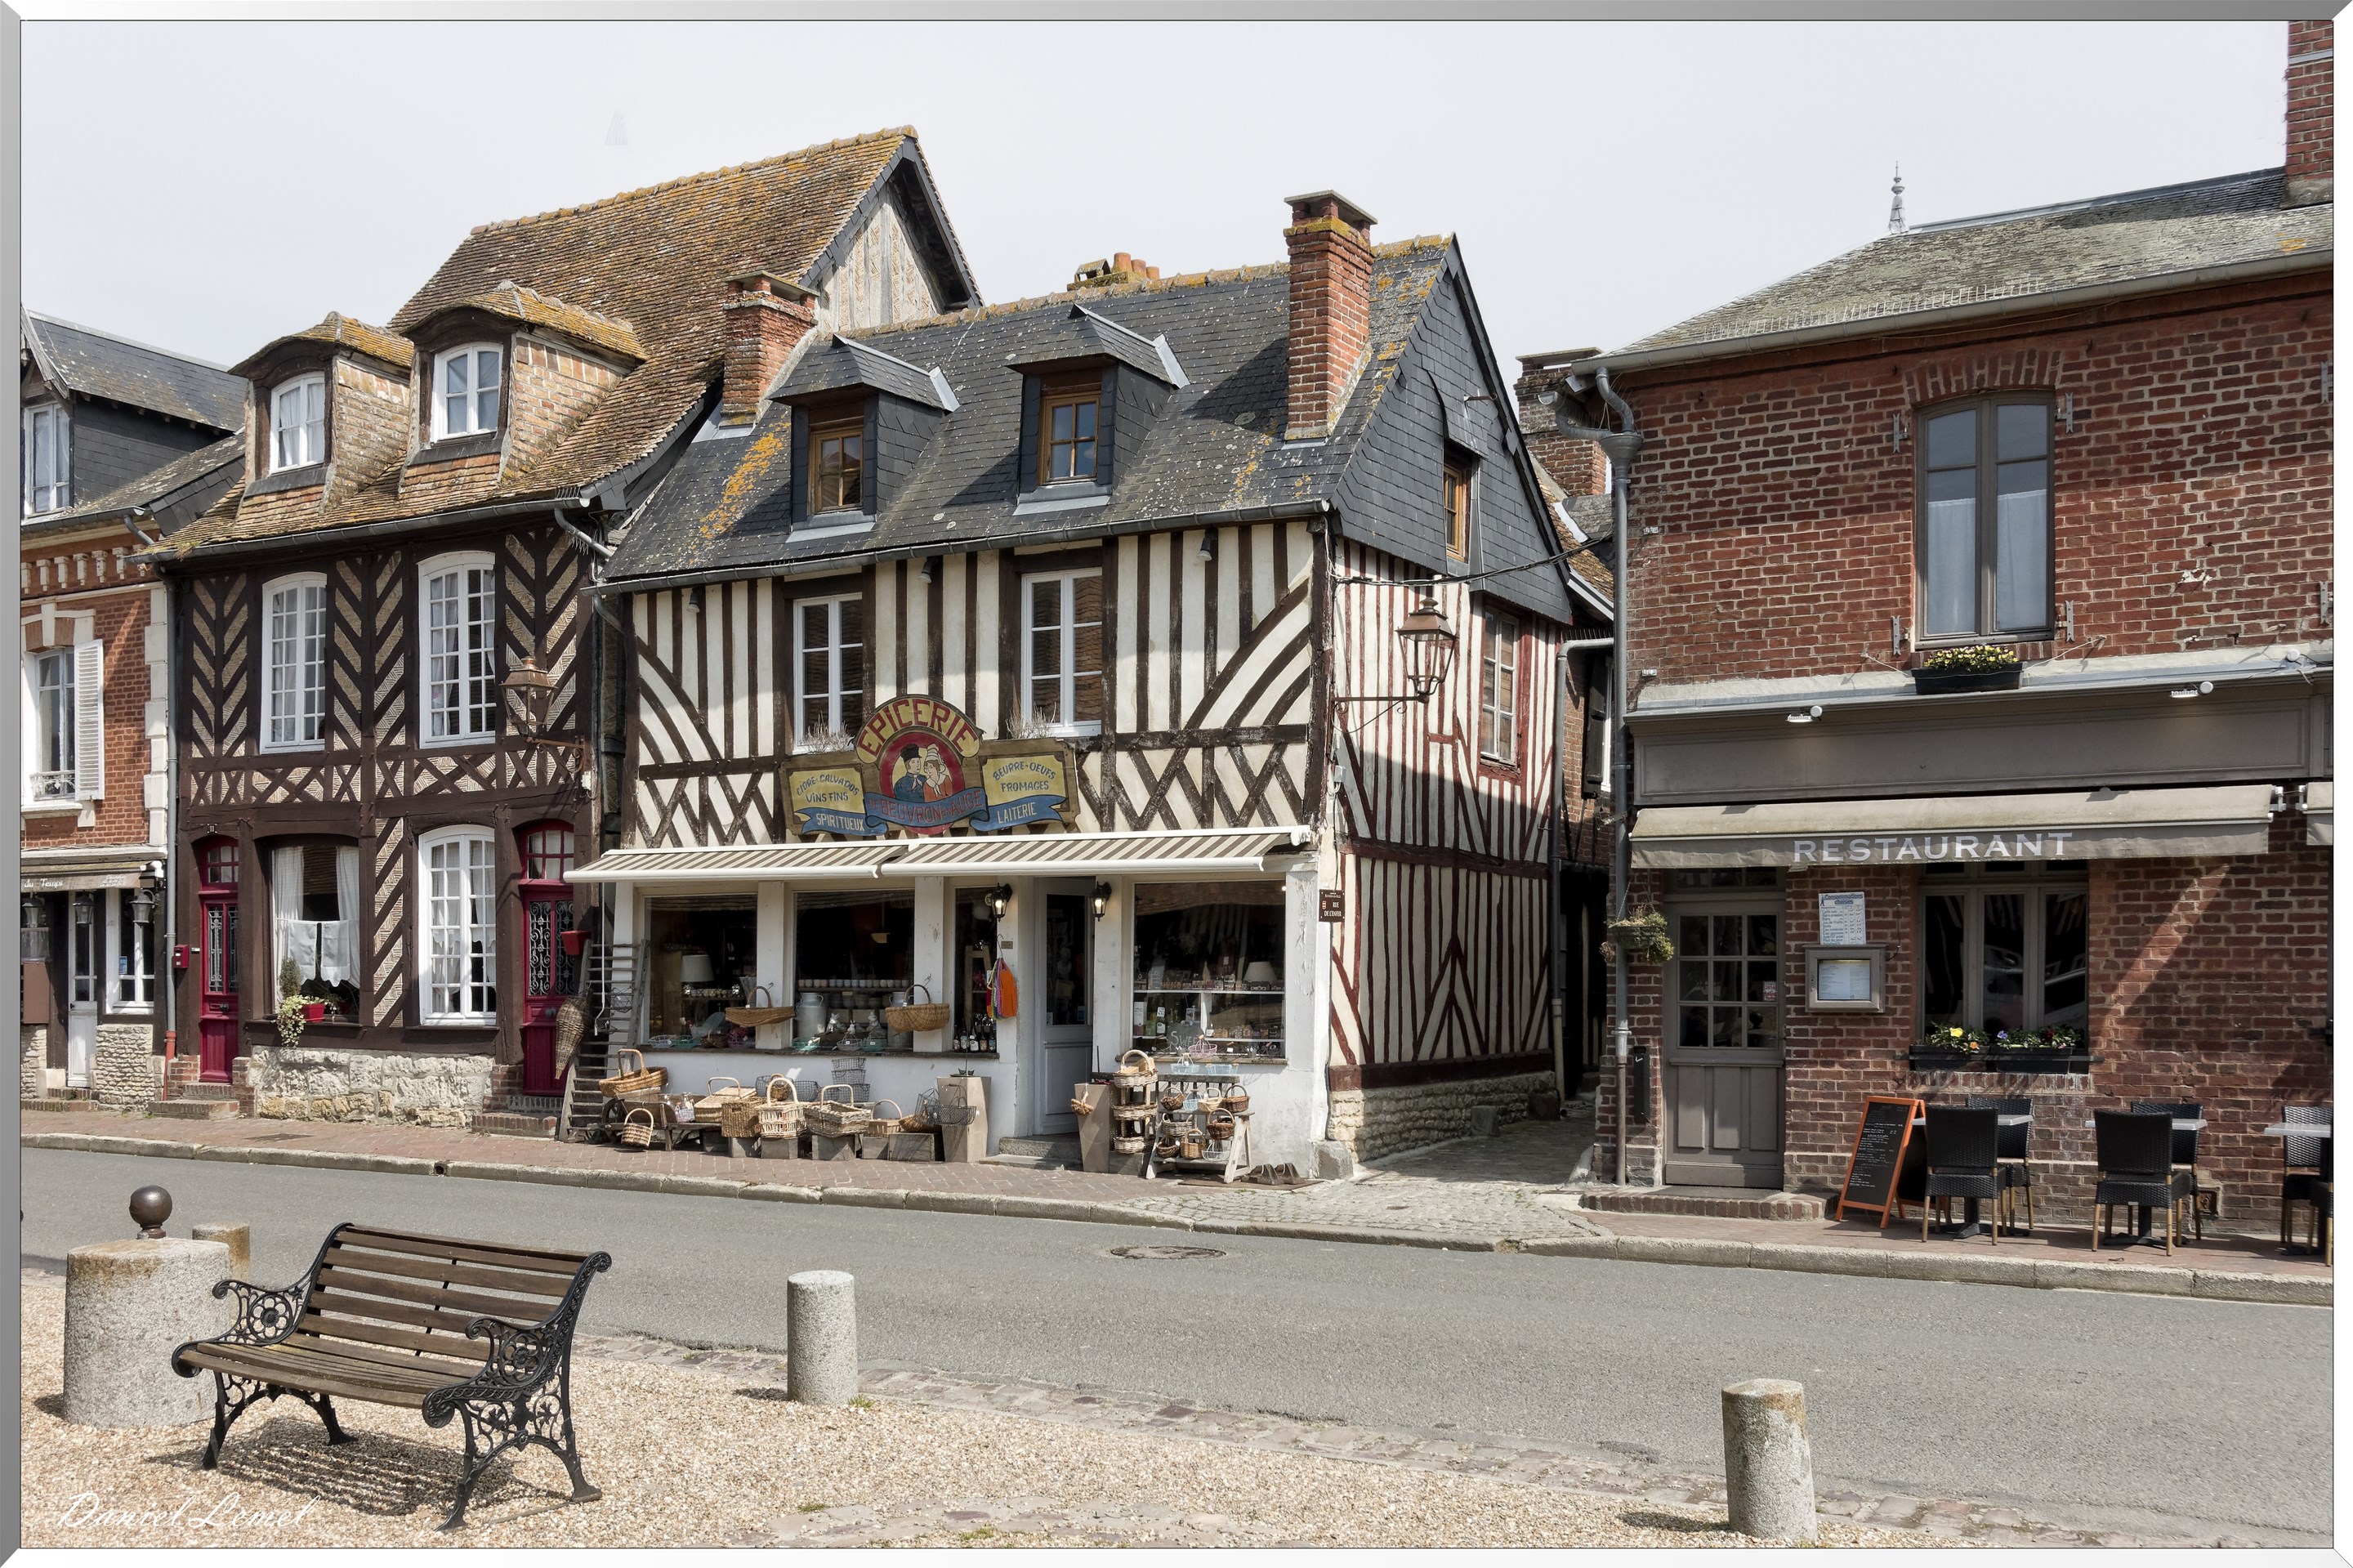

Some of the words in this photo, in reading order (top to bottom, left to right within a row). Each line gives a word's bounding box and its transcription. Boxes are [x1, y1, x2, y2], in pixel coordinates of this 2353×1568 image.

[858, 699, 978, 757] EPICERIE
[1001, 780, 1049, 793] FROMAGES
[880, 797, 942, 824] BEUVRON
[950, 789, 984, 816] AUGE
[998, 802, 1037, 824] LAITERIE
[815, 813, 864, 831] SPIRITUEUX
[1793, 831, 2074, 863] RESTAURANT
[24, 878, 33, 888] du
[40, 878, 64, 889] Temps
